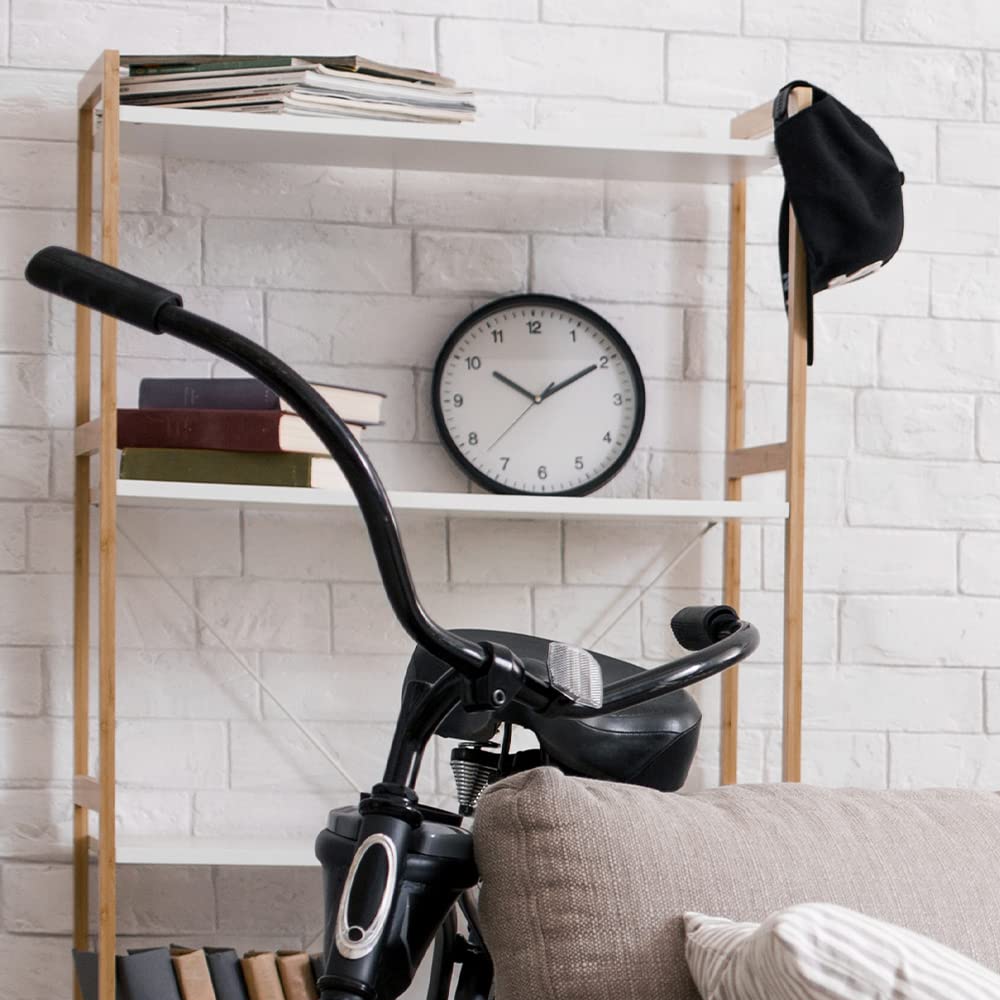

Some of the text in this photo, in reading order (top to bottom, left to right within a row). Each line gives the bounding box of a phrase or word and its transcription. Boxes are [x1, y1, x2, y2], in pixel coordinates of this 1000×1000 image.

[526, 320, 542, 335] 12
[491, 330, 503, 343] 11
[569, 330, 577, 342] 1
[465, 356, 481, 369] 10
[599, 355, 609, 369] 2
[453, 394, 463, 408] 9
[613, 393, 623, 407] 3
[468, 431, 478, 446] 8
[602, 431, 612, 444] 4
[500, 457, 510, 471] 7
[574, 456, 584, 470] 5
[538, 466, 547, 479] 6
